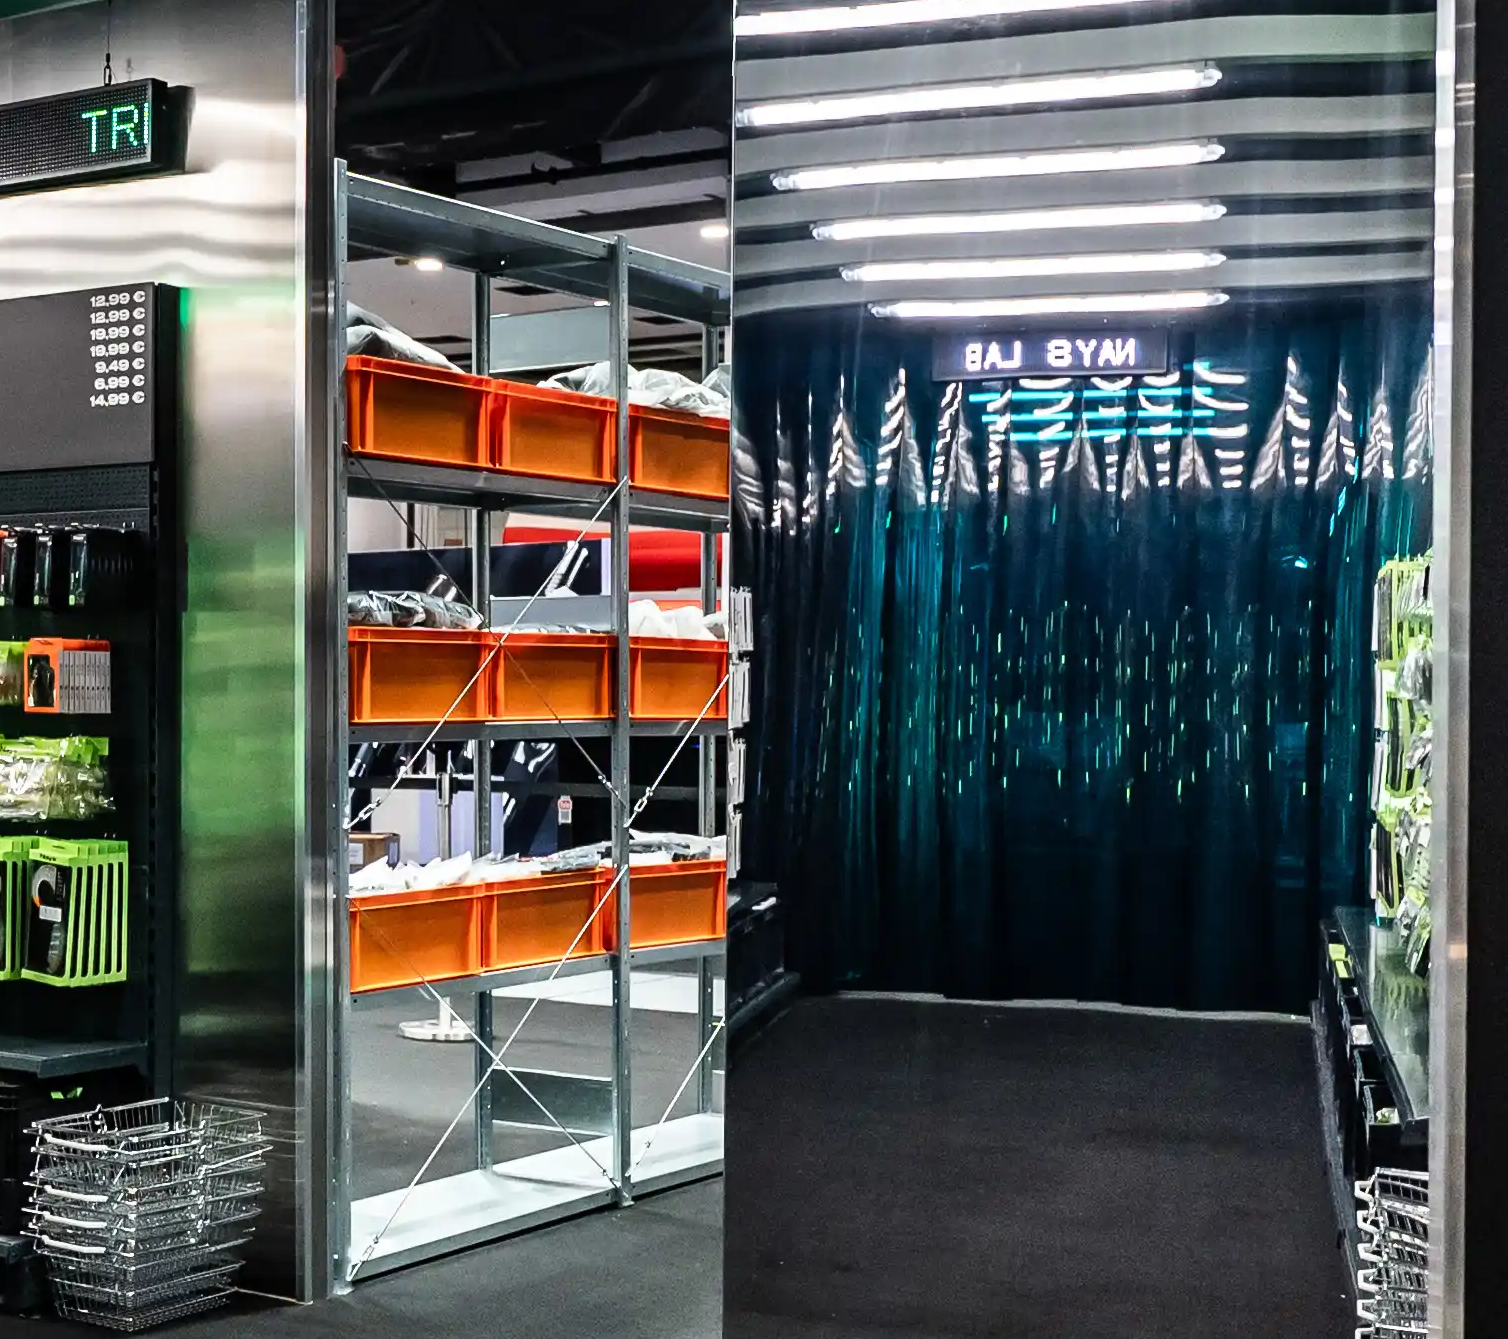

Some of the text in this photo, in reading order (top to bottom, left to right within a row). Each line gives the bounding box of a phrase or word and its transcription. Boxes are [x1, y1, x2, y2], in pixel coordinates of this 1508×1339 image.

[133, 290, 146, 302] €
[133, 307, 145, 319] €
[133, 324, 145, 336] €
[132, 341, 145, 353] €
[132, 357, 145, 370] €
[132, 374, 145, 387] €
[132, 391, 145, 403] €
